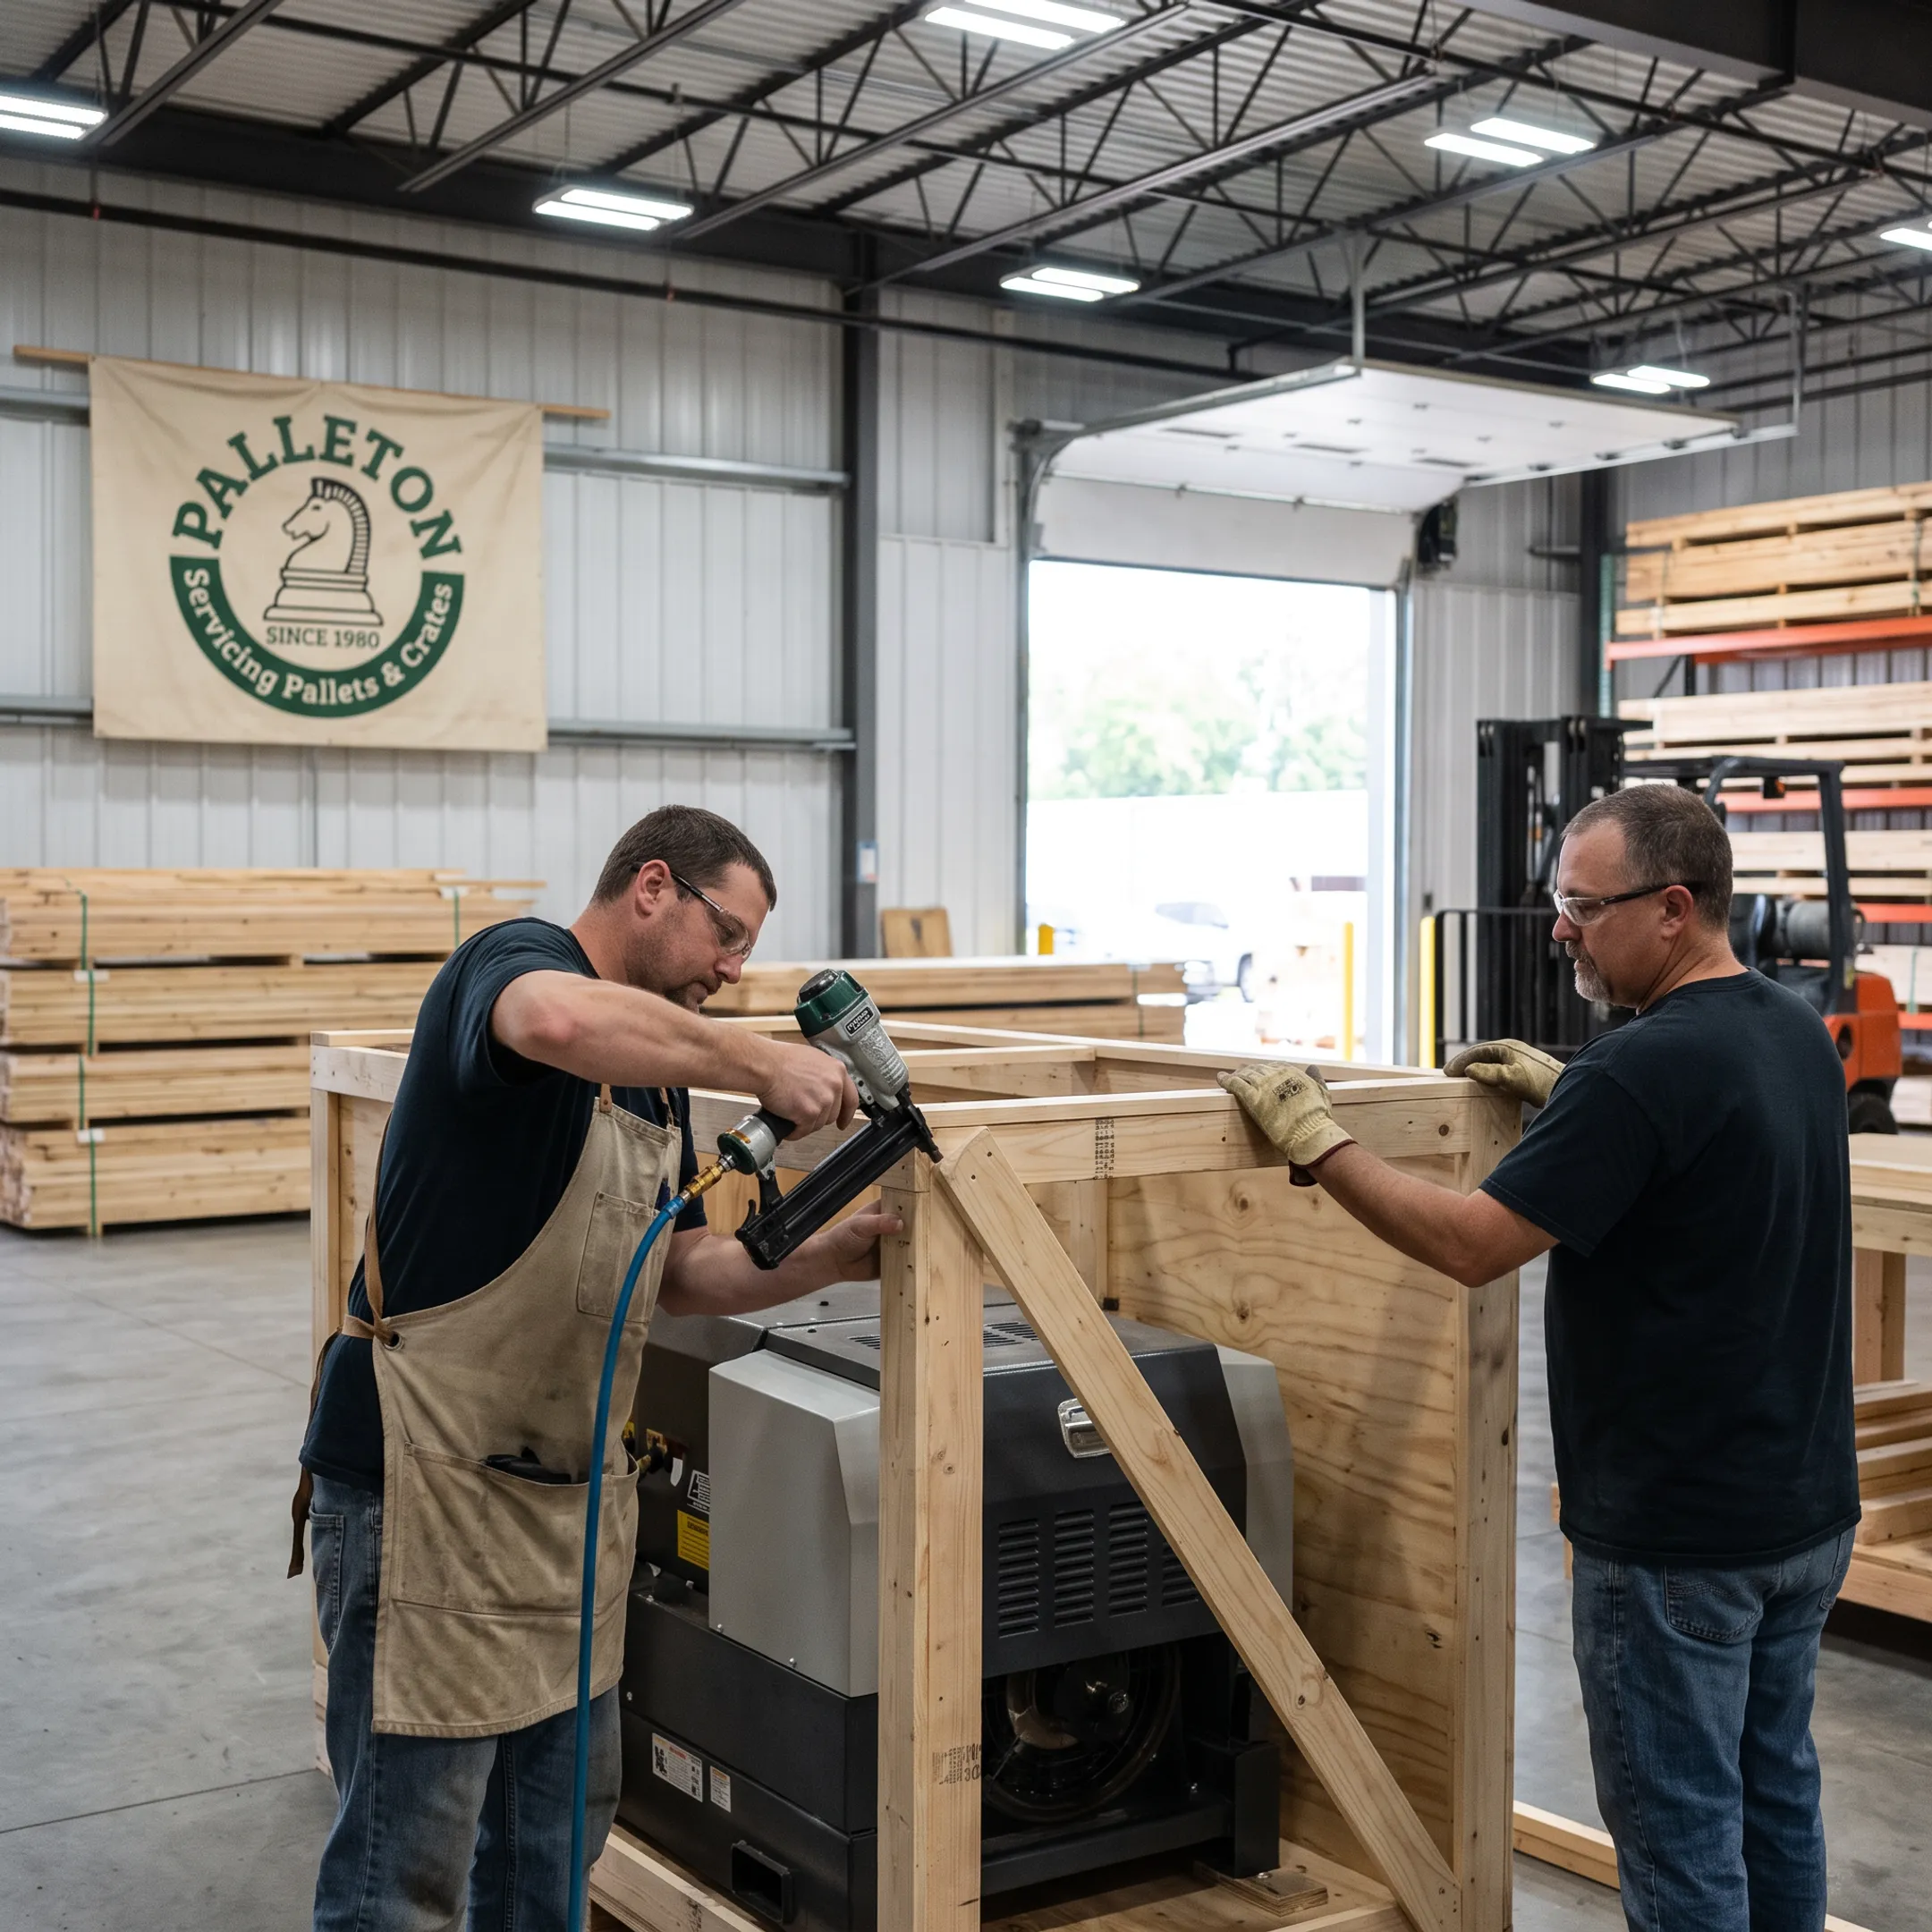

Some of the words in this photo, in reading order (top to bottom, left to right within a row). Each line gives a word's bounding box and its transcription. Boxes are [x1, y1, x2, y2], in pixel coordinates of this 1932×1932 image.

[172, 414, 462, 559] PALLETON
[184, 568, 279, 696] Servicing
[281, 673, 380, 706] Pallets
[380, 661, 406, 688] &
[401, 583, 453, 667] Crates
[266, 626, 329, 647] SINCE
[334, 630, 381, 649] 1980
